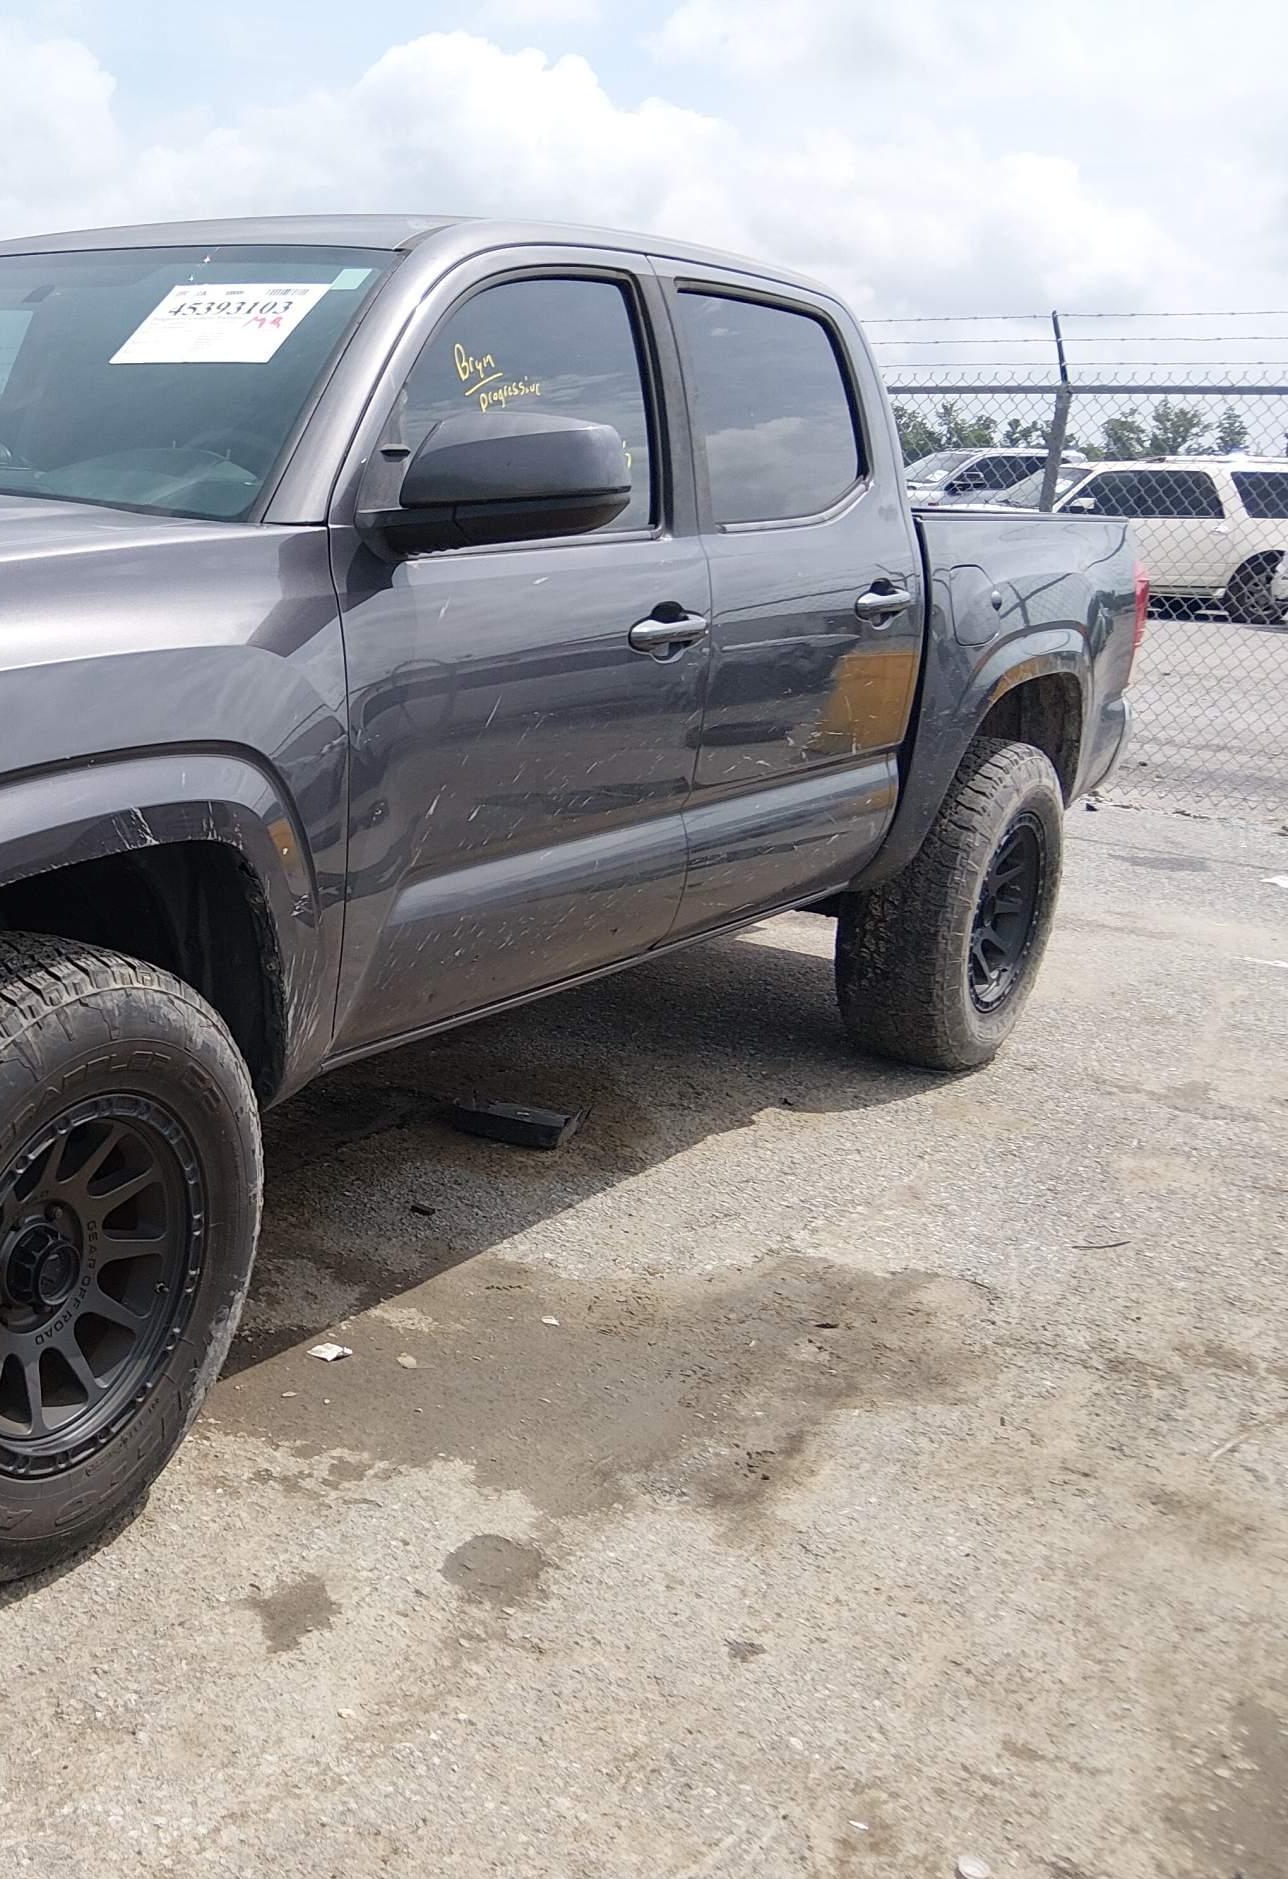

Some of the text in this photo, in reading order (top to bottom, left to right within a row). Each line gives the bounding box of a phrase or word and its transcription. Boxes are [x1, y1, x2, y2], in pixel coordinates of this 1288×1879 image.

[167, 301, 294, 316] 45393103
[34, 1220, 99, 1346] GEAR OFF ROAD
